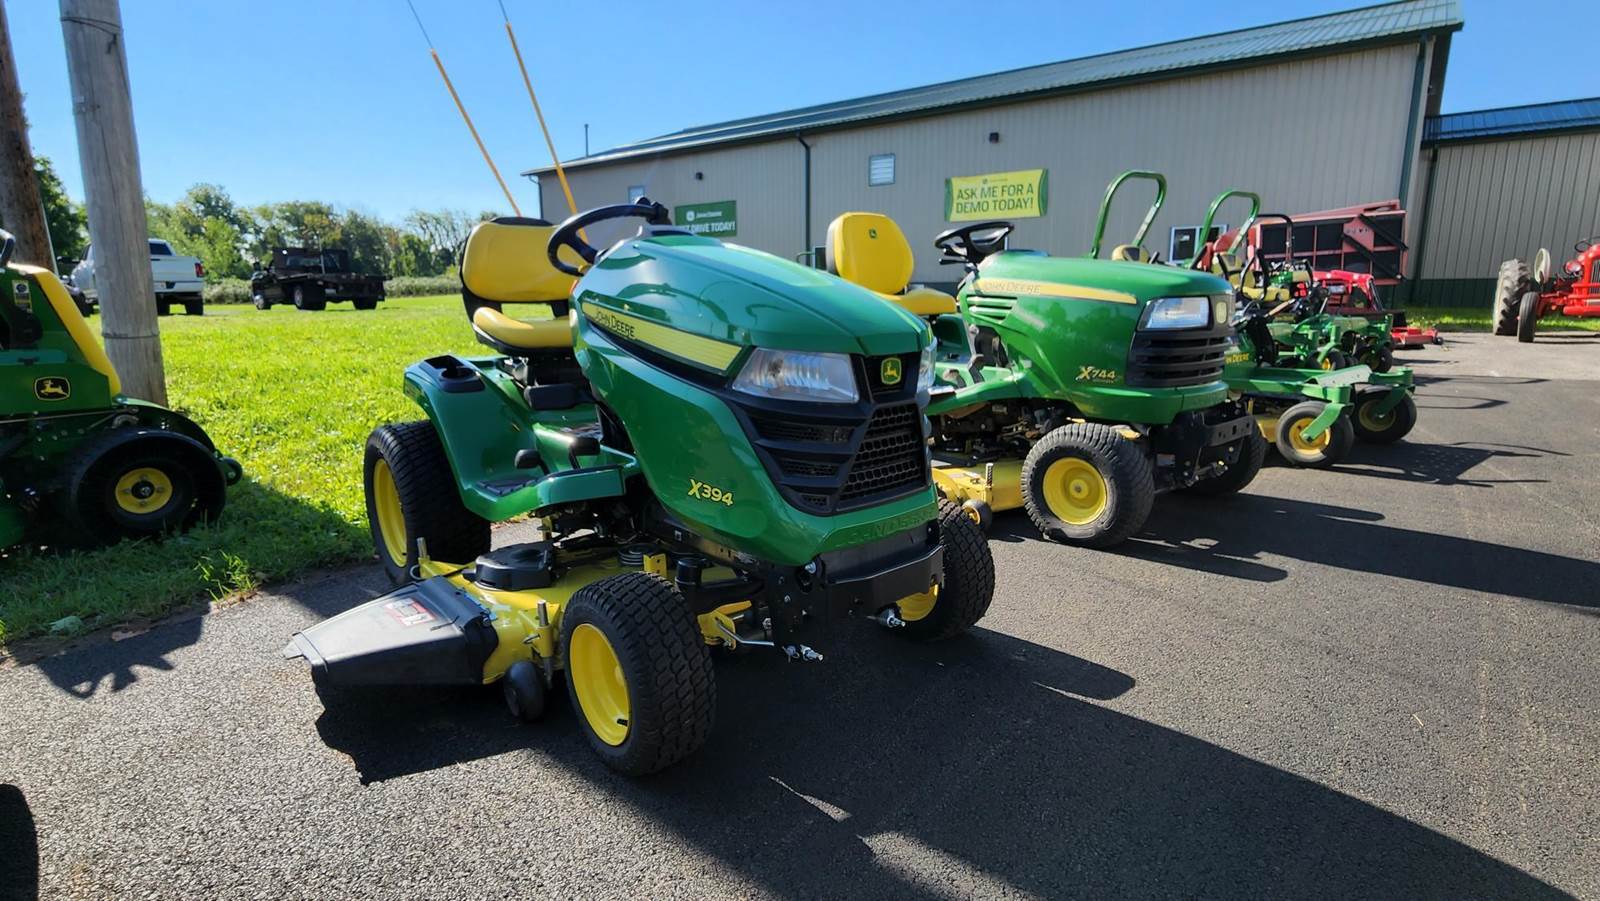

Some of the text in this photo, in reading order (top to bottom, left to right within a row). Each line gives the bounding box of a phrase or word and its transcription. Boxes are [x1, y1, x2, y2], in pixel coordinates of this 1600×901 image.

[957, 183, 1034, 200] ASK ME FOR A
[956, 197, 1033, 214] DEMO TODAY!
[711, 221, 735, 232] TODAY!
[610, 314, 635, 337] DEERE
[1075, 366, 1116, 381] X744
[688, 479, 733, 506] X394
